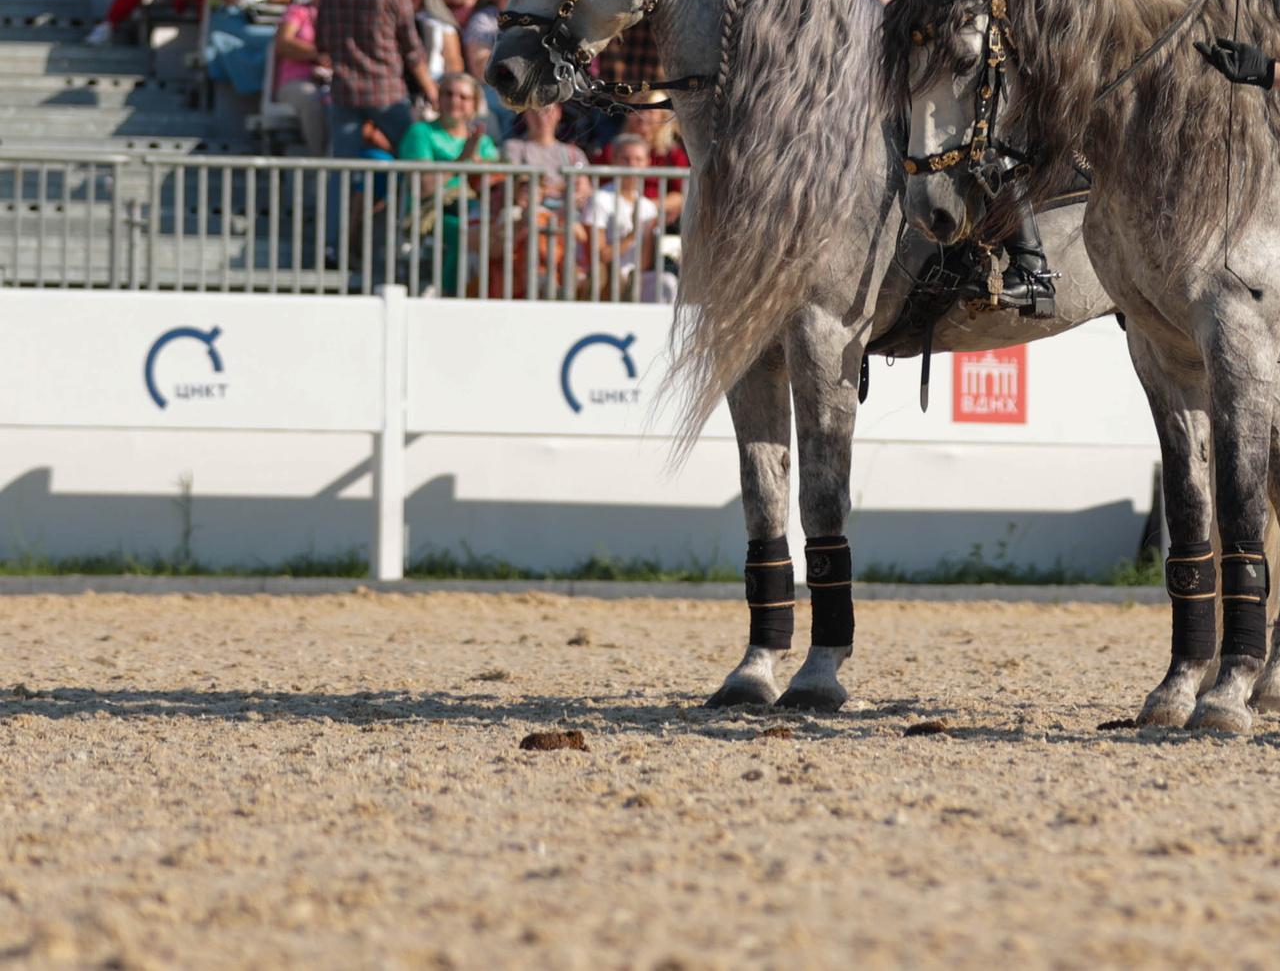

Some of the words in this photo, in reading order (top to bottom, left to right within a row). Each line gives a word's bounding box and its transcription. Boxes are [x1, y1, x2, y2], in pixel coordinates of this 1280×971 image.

[175, 383, 228, 400] ЦНКТ
[589, 389, 641, 405] ЦНКТ
[961, 395, 1019, 414] ВДНХ
